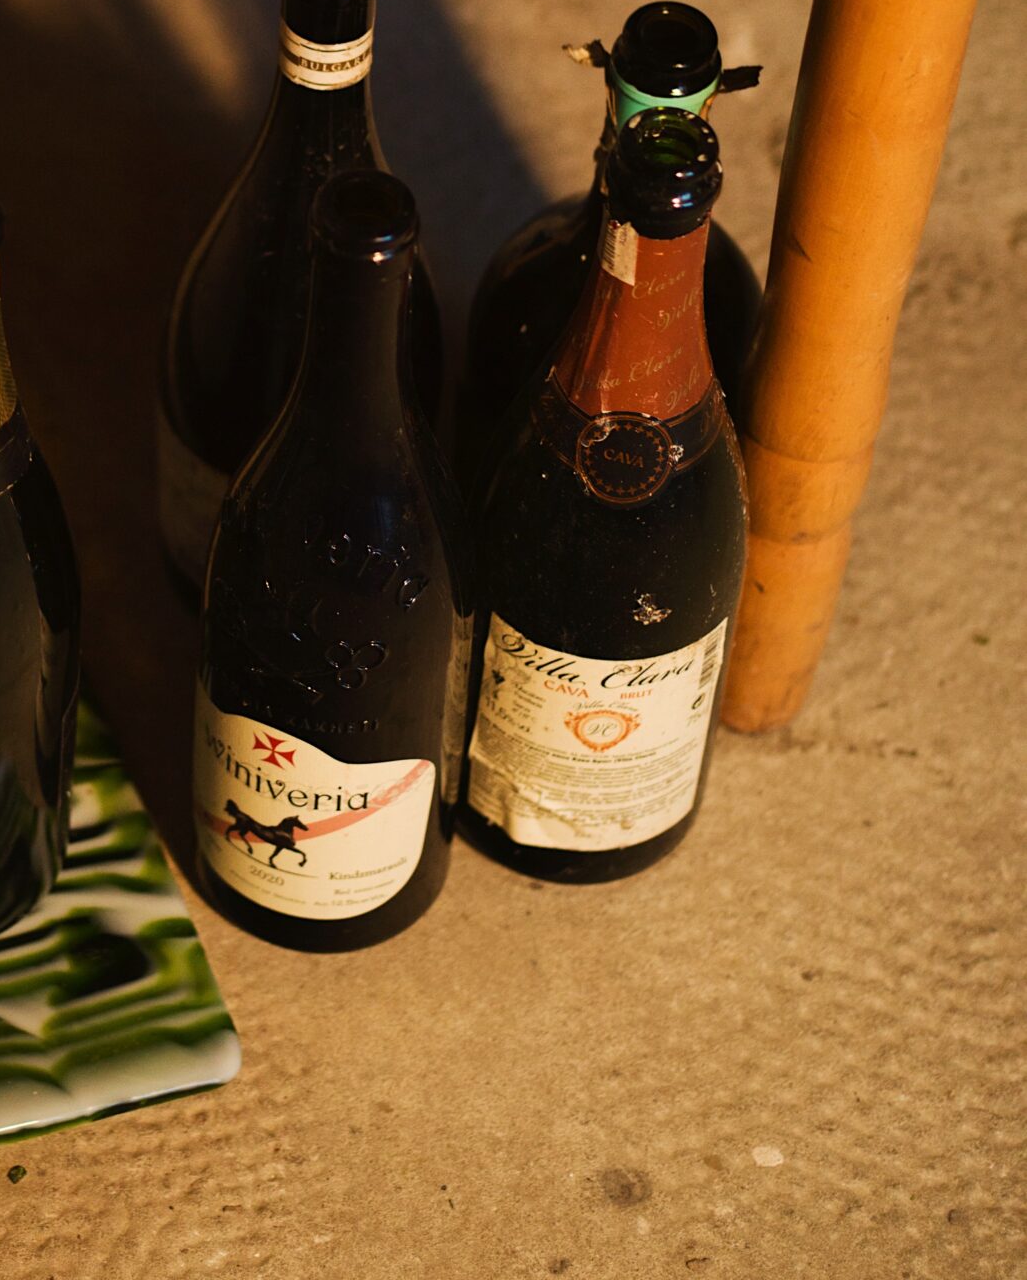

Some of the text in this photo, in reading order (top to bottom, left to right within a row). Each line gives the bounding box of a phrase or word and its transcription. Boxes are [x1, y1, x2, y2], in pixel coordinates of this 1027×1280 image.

[603, 448, 646, 469] CAVA
[500, 632, 694, 689] Villa Clara
[543, 679, 654, 701] CAVA BRUT
